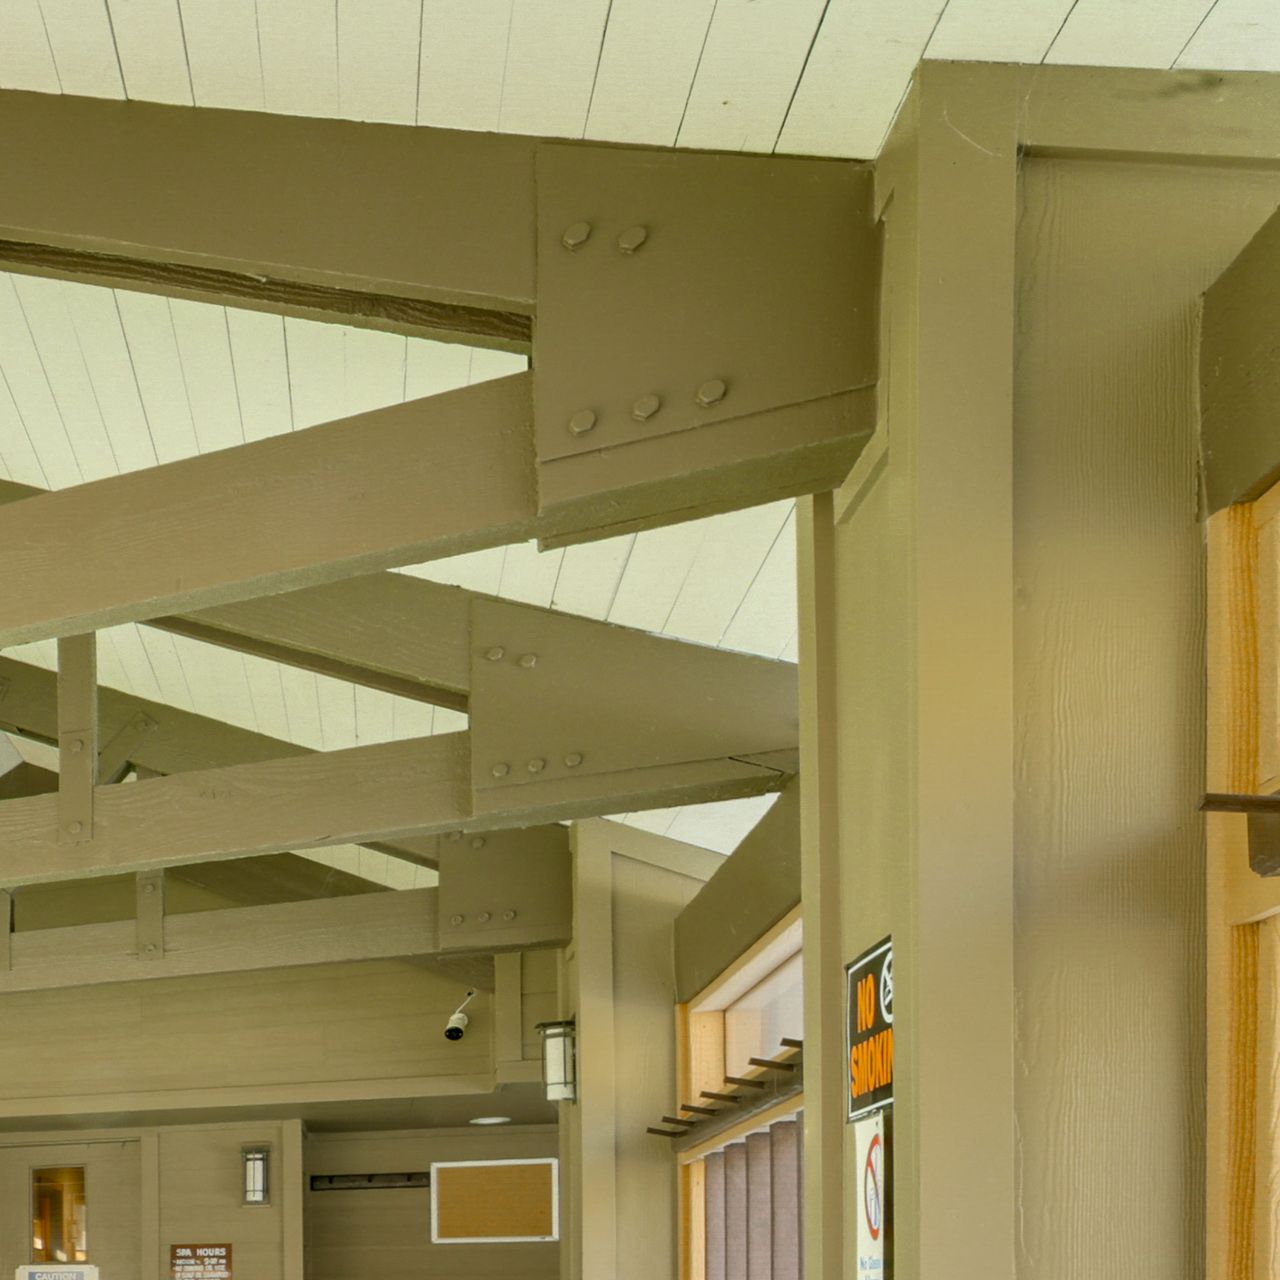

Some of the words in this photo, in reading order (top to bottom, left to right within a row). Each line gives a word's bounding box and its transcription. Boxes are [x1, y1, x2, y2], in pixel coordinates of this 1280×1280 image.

[857, 973, 875, 1034] NO
[850, 1027, 894, 1099] SMOKIN
[176, 1248, 192, 1257] SPA
[196, 1247, 226, 1257] HOURS
[35, 1272, 77, 1280] CAUTION
